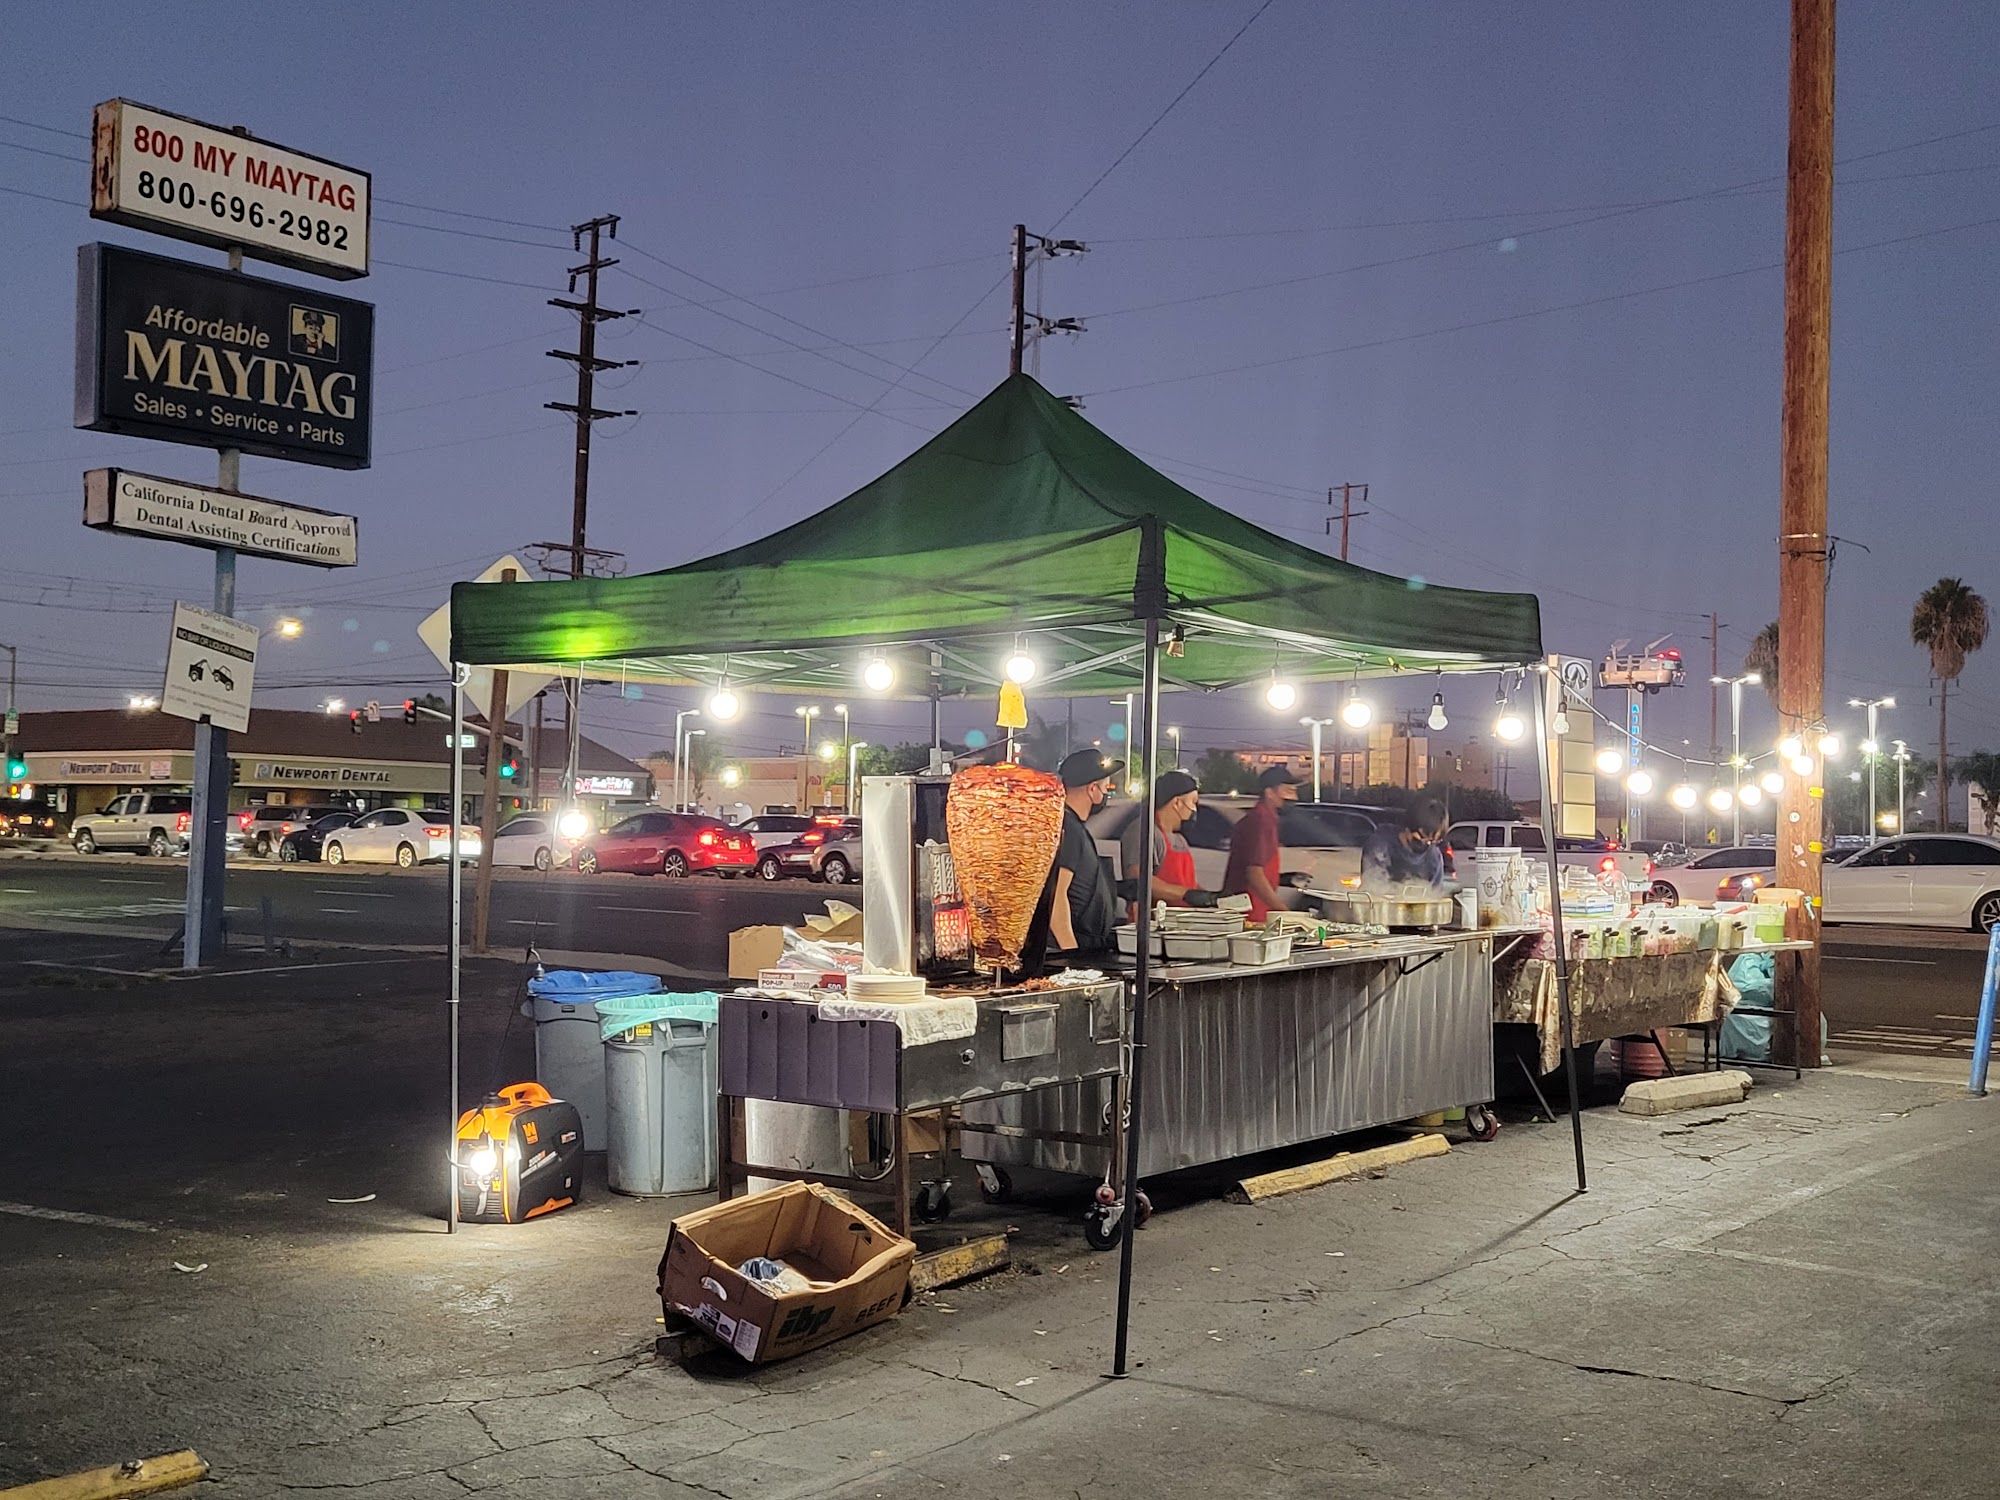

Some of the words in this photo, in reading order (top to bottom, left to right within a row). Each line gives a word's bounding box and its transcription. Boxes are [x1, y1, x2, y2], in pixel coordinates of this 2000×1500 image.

[134, 125, 184, 163] 800
[193, 141, 237, 178] MY
[245, 156, 356, 212] MAYTAG
[138, 170, 349, 251] 800-696-2982
[145, 304, 271, 350] Affordable
[124, 329, 356, 420] MAYTAG
[134, 392, 187, 419] Sales
[210, 405, 279, 435] Service
[300, 421, 345, 447] Parts
[122, 482, 195, 511] California
[199, 499, 245, 521] Dental
[248, 510, 288, 530] Board
[291, 518, 352, 538] Approved
[136, 508, 184, 532] Dental
[186, 518, 248, 547] Assisting
[251, 531, 341, 558] Certifications
[69, 763, 108, 774] NEWPORT
[109, 763, 142, 774] DENTAL
[273, 766, 339, 780] NEWPORT
[341, 769, 391, 782] DENTAL
[855, 1292, 898, 1324] BEEF
